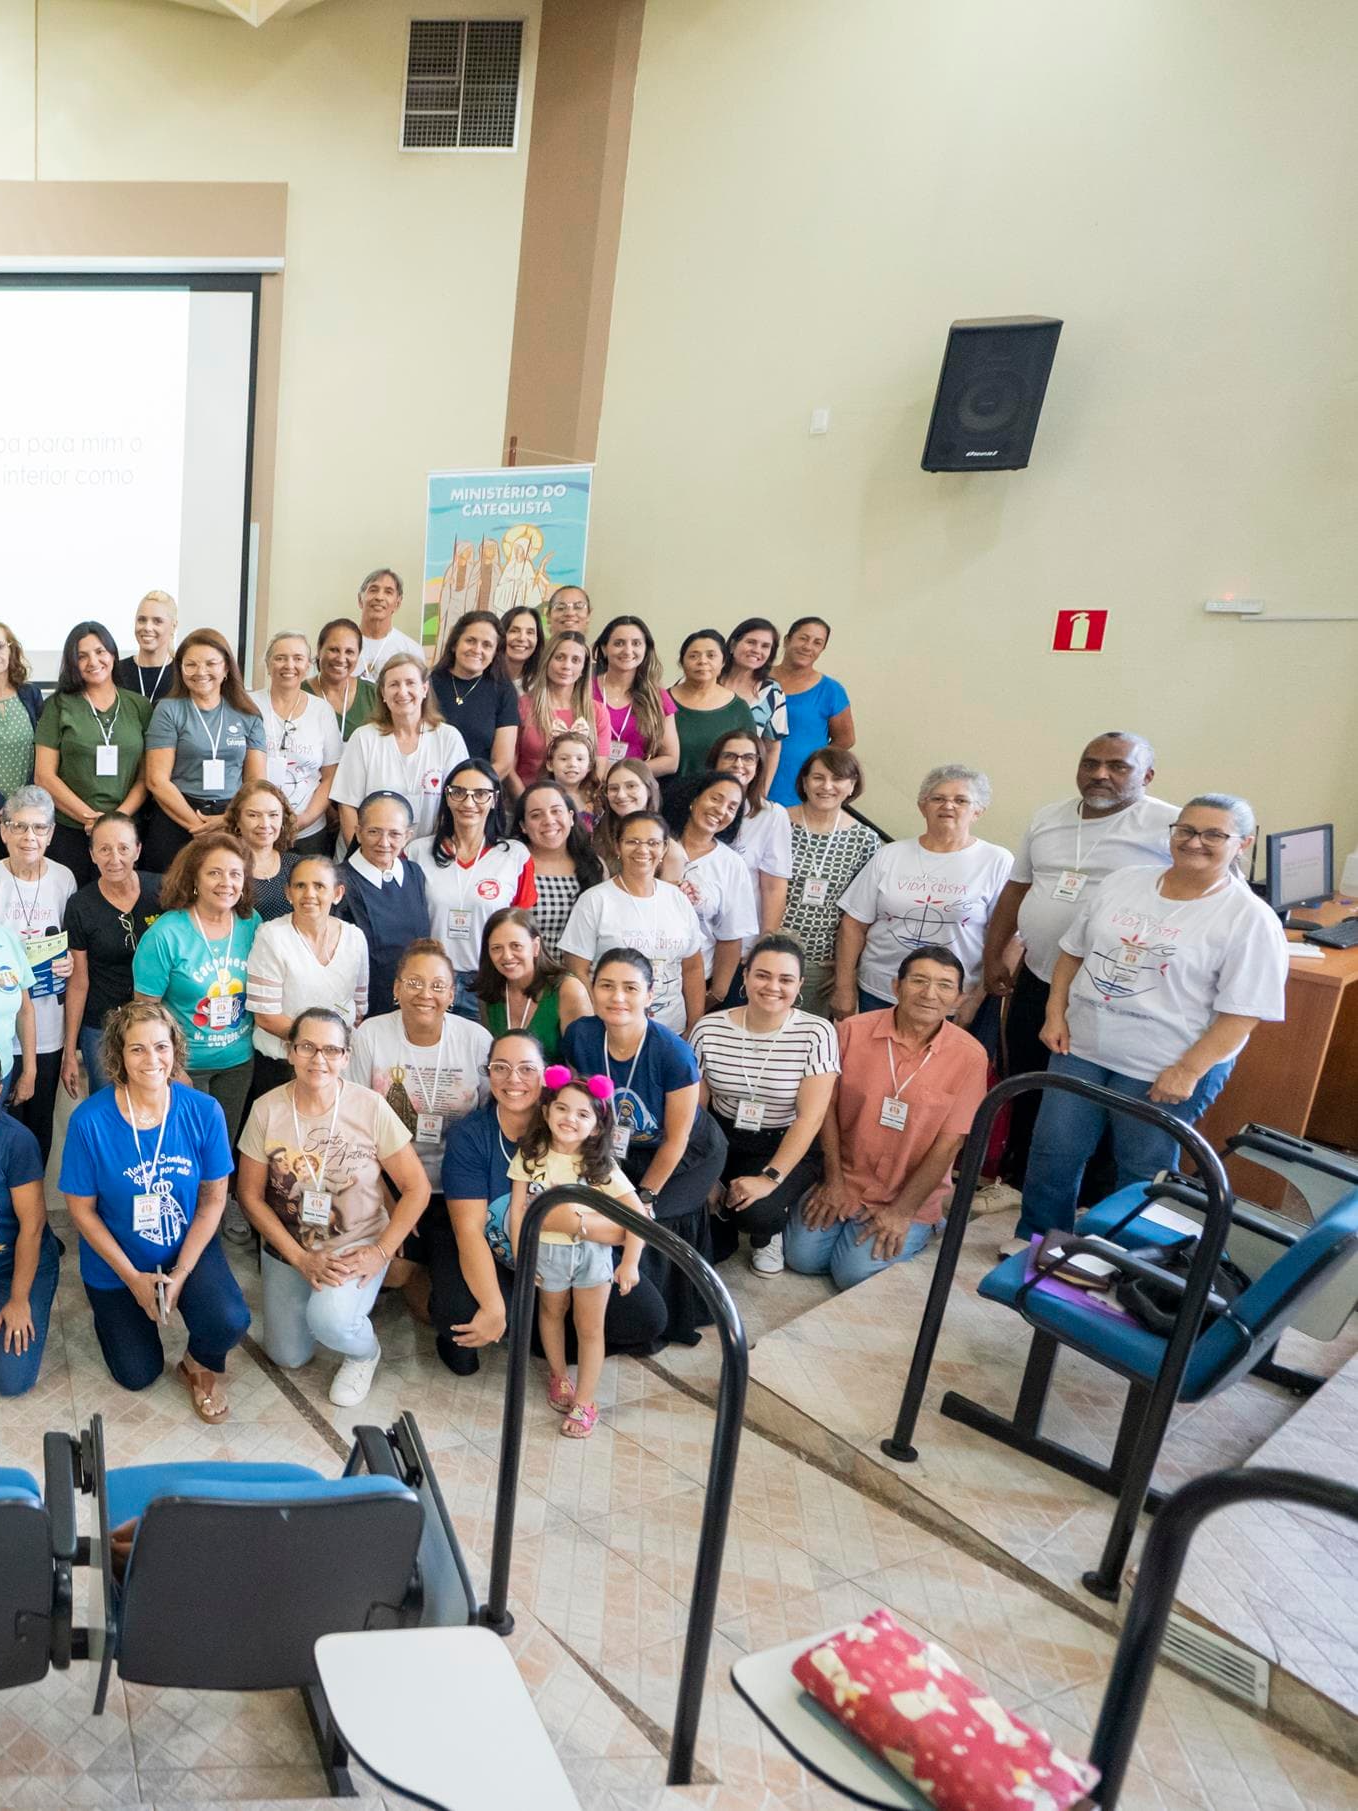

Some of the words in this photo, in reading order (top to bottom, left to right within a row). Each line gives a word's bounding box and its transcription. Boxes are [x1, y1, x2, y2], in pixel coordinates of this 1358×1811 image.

[27, 436, 74, 460] para
[81, 432, 123, 454] mim
[3, 463, 68, 486] interior
[74, 468, 134, 486] como
[450, 484, 538, 501] MINISTÉRIO
[542, 484, 567, 498] DO
[462, 501, 553, 517] CATEQUISTA
[898, 880, 926, 892] VIDA
[193, 956, 248, 983] Cateques
[303, 1127, 344, 1152] Santo
[157, 1153, 193, 1167] Senhora
[159, 1166, 175, 1178] por
